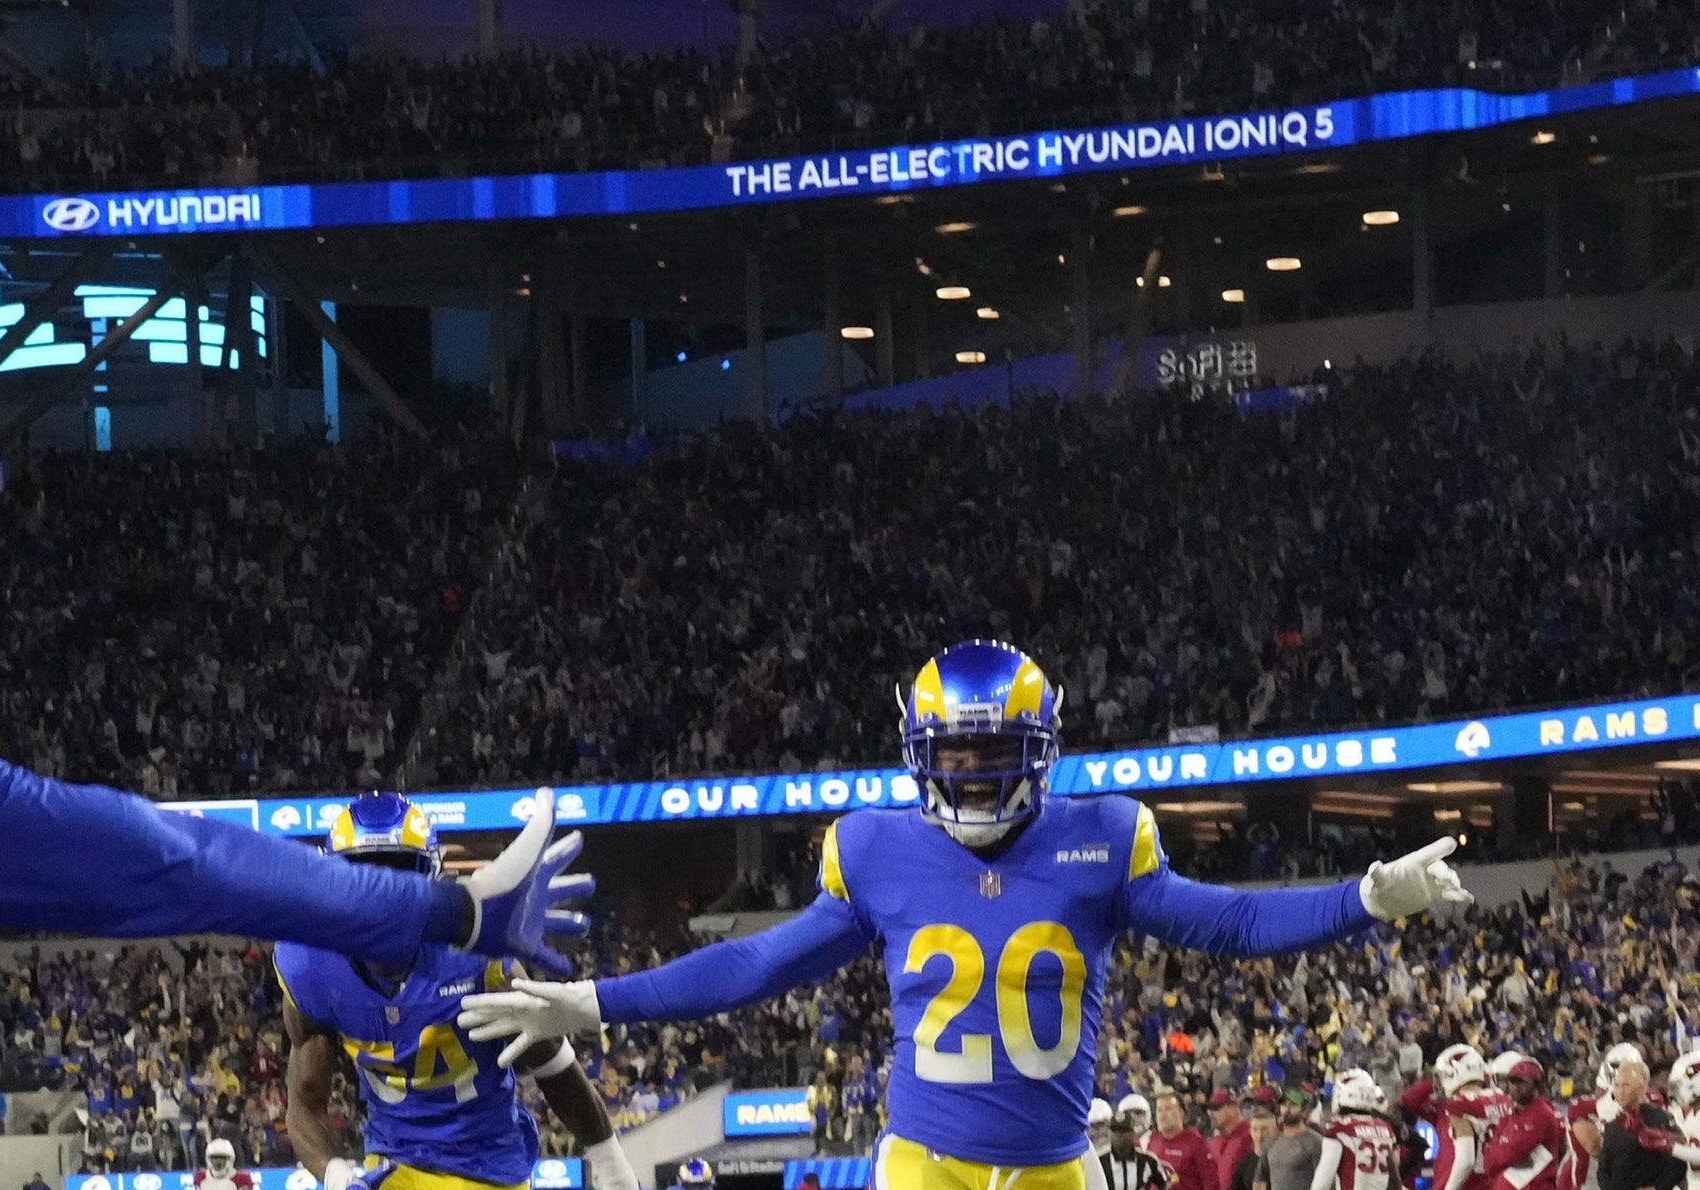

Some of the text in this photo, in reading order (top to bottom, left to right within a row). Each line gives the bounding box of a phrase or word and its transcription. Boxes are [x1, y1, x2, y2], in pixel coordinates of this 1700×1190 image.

[726, 108, 1334, 196] THE ALL-ELECTRIC HYUNDAI IONIQ 5
[108, 193, 260, 227] HYUNDAI
[1540, 707, 1668, 747] RAMS
[1085, 736, 1397, 786] YOUR HOUSE
[661, 775, 920, 814] OUR HOUS
[1056, 850, 1109, 863] RAMS
[903, 920, 1088, 1084] 20
[341, 1023, 479, 1104] 54
